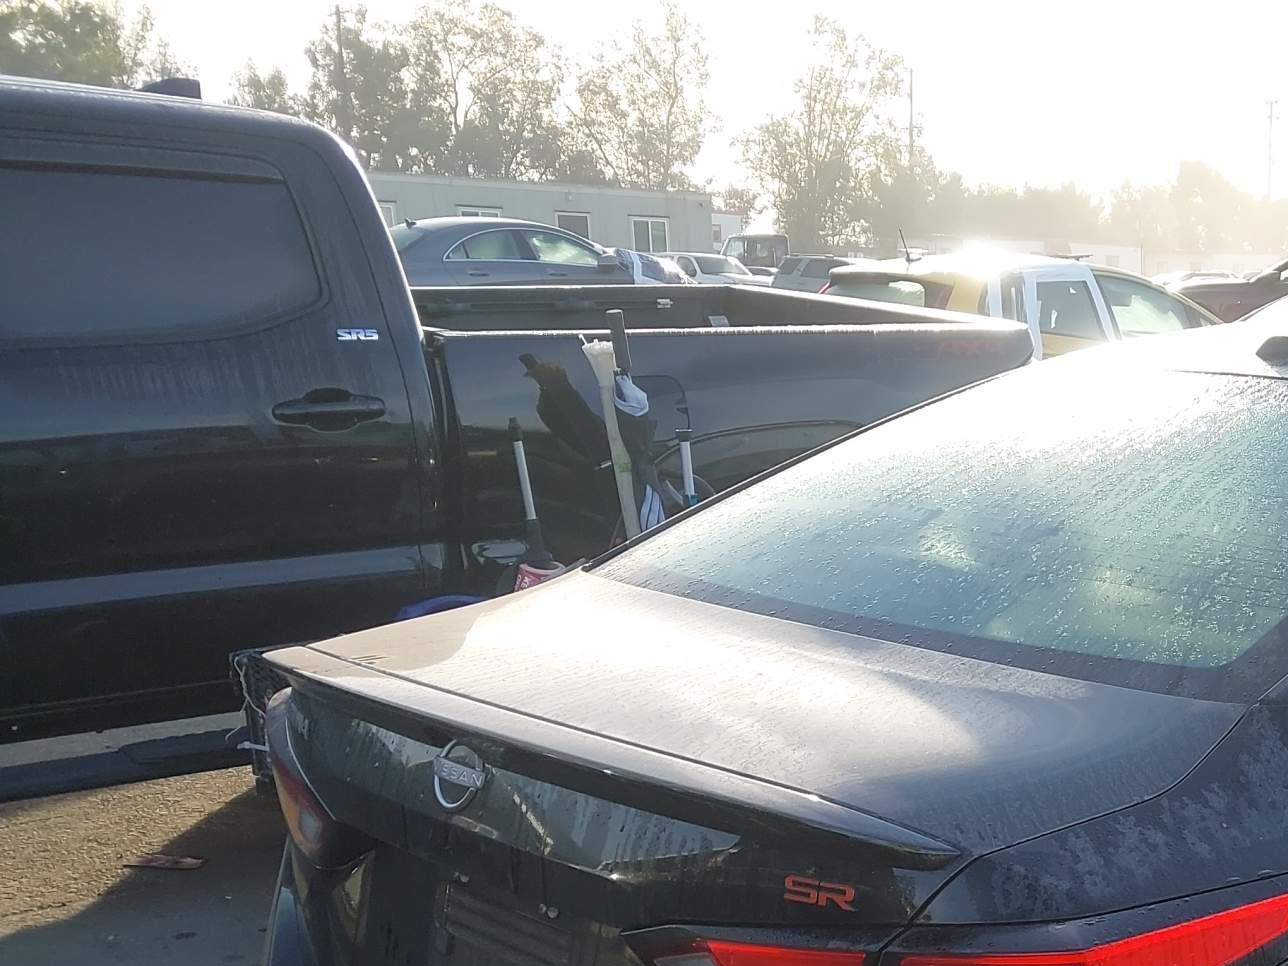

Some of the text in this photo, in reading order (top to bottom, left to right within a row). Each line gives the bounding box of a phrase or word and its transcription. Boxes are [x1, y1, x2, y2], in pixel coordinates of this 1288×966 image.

[336, 328, 379, 341] SR5
[434, 757, 484, 787] SSAN
[783, 873, 857, 913] SR
